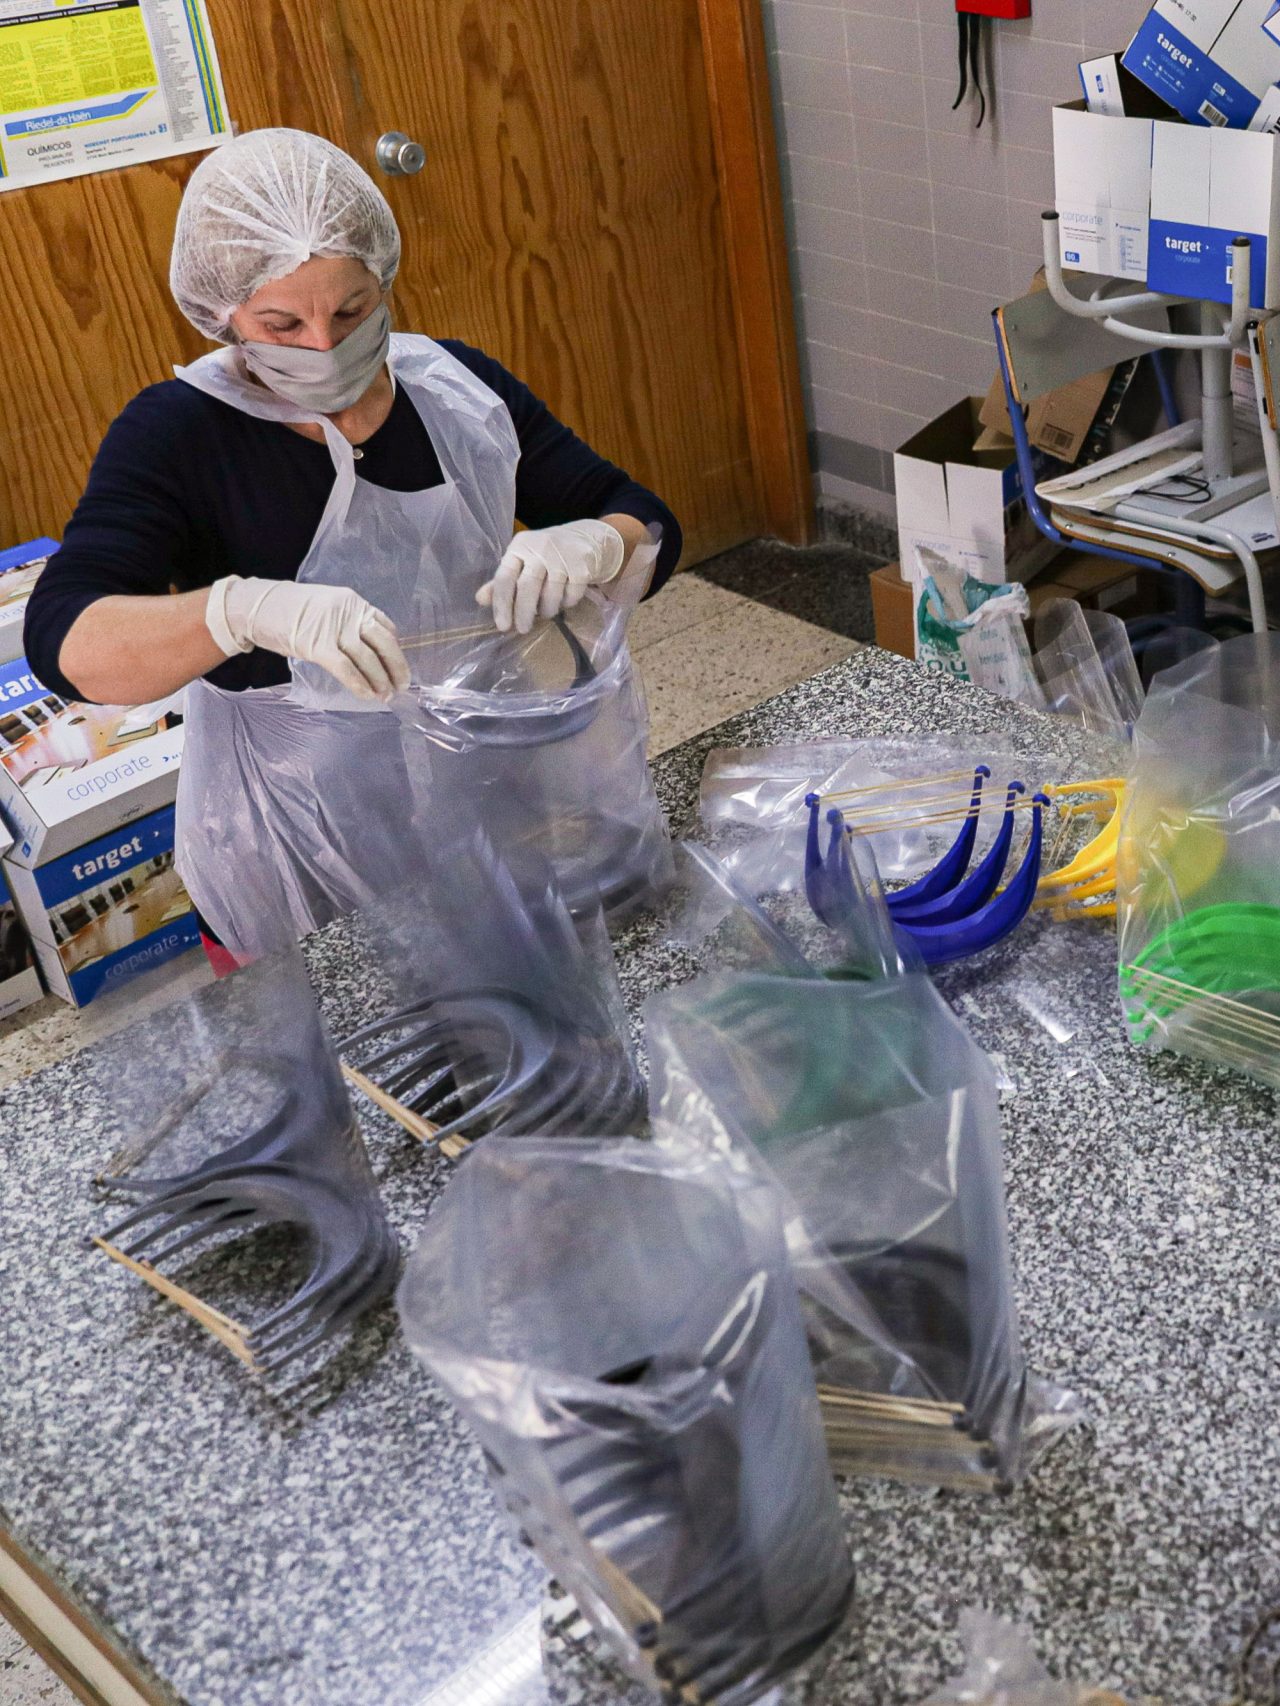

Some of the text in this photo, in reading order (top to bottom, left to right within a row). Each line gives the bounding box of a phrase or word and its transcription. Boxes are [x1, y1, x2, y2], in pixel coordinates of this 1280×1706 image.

[1156, 32, 1193, 70] target
[1062, 211, 1103, 225] corporate
[1165, 236, 1202, 254] target
[67, 754, 152, 801] corporate
[72, 836, 143, 881] target
[105, 934, 179, 980] corporate
